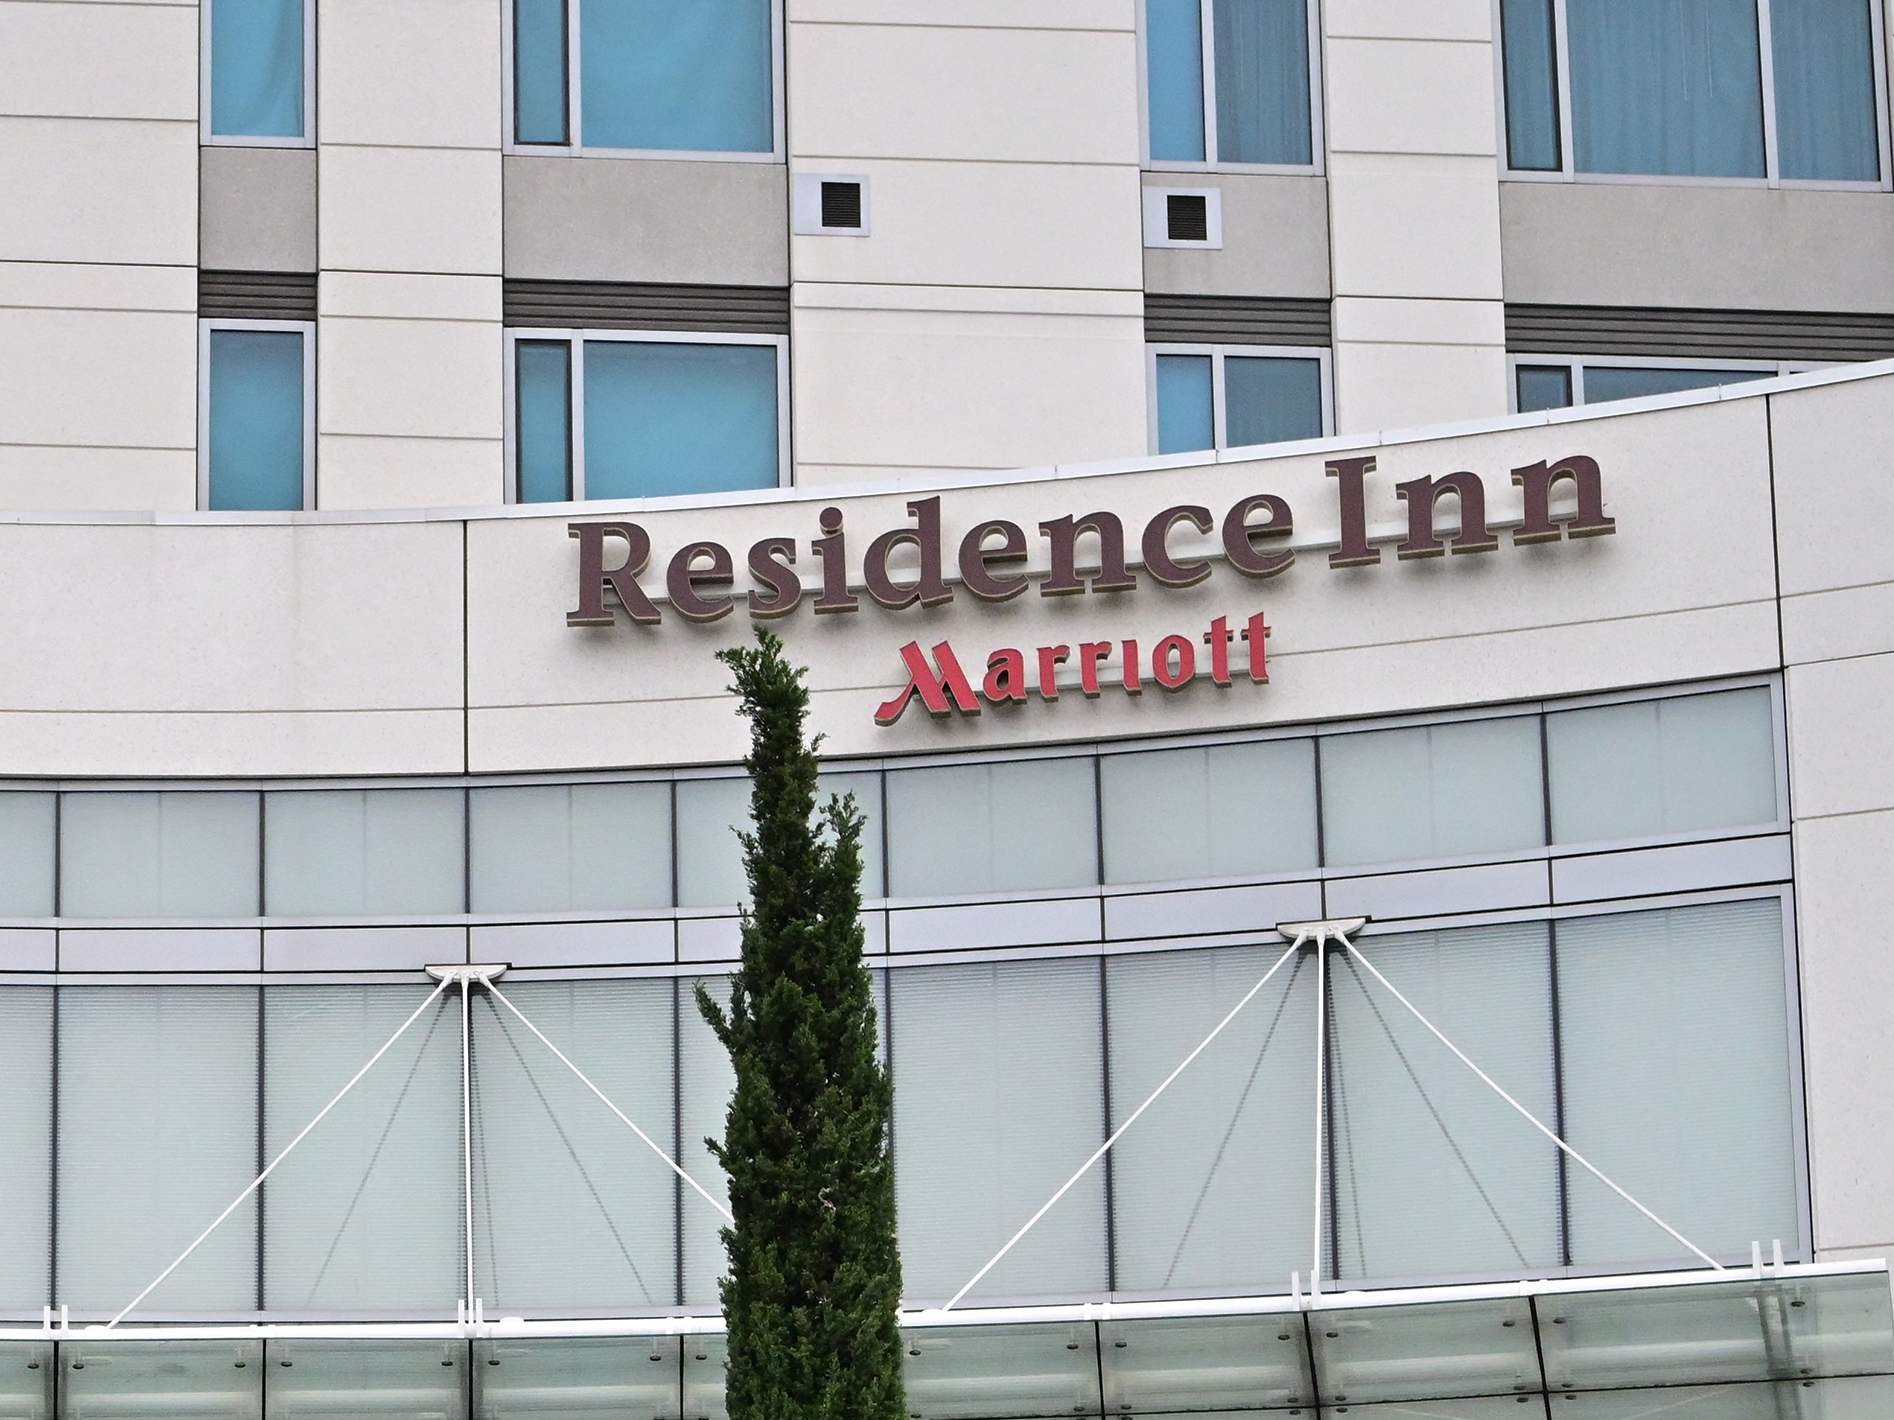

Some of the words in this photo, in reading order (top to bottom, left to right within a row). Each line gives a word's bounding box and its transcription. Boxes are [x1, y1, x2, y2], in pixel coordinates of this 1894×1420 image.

[567, 494, 1296, 627] Residence
[1325, 455, 1616, 569] Inn
[874, 611, 1271, 727] Marriott
